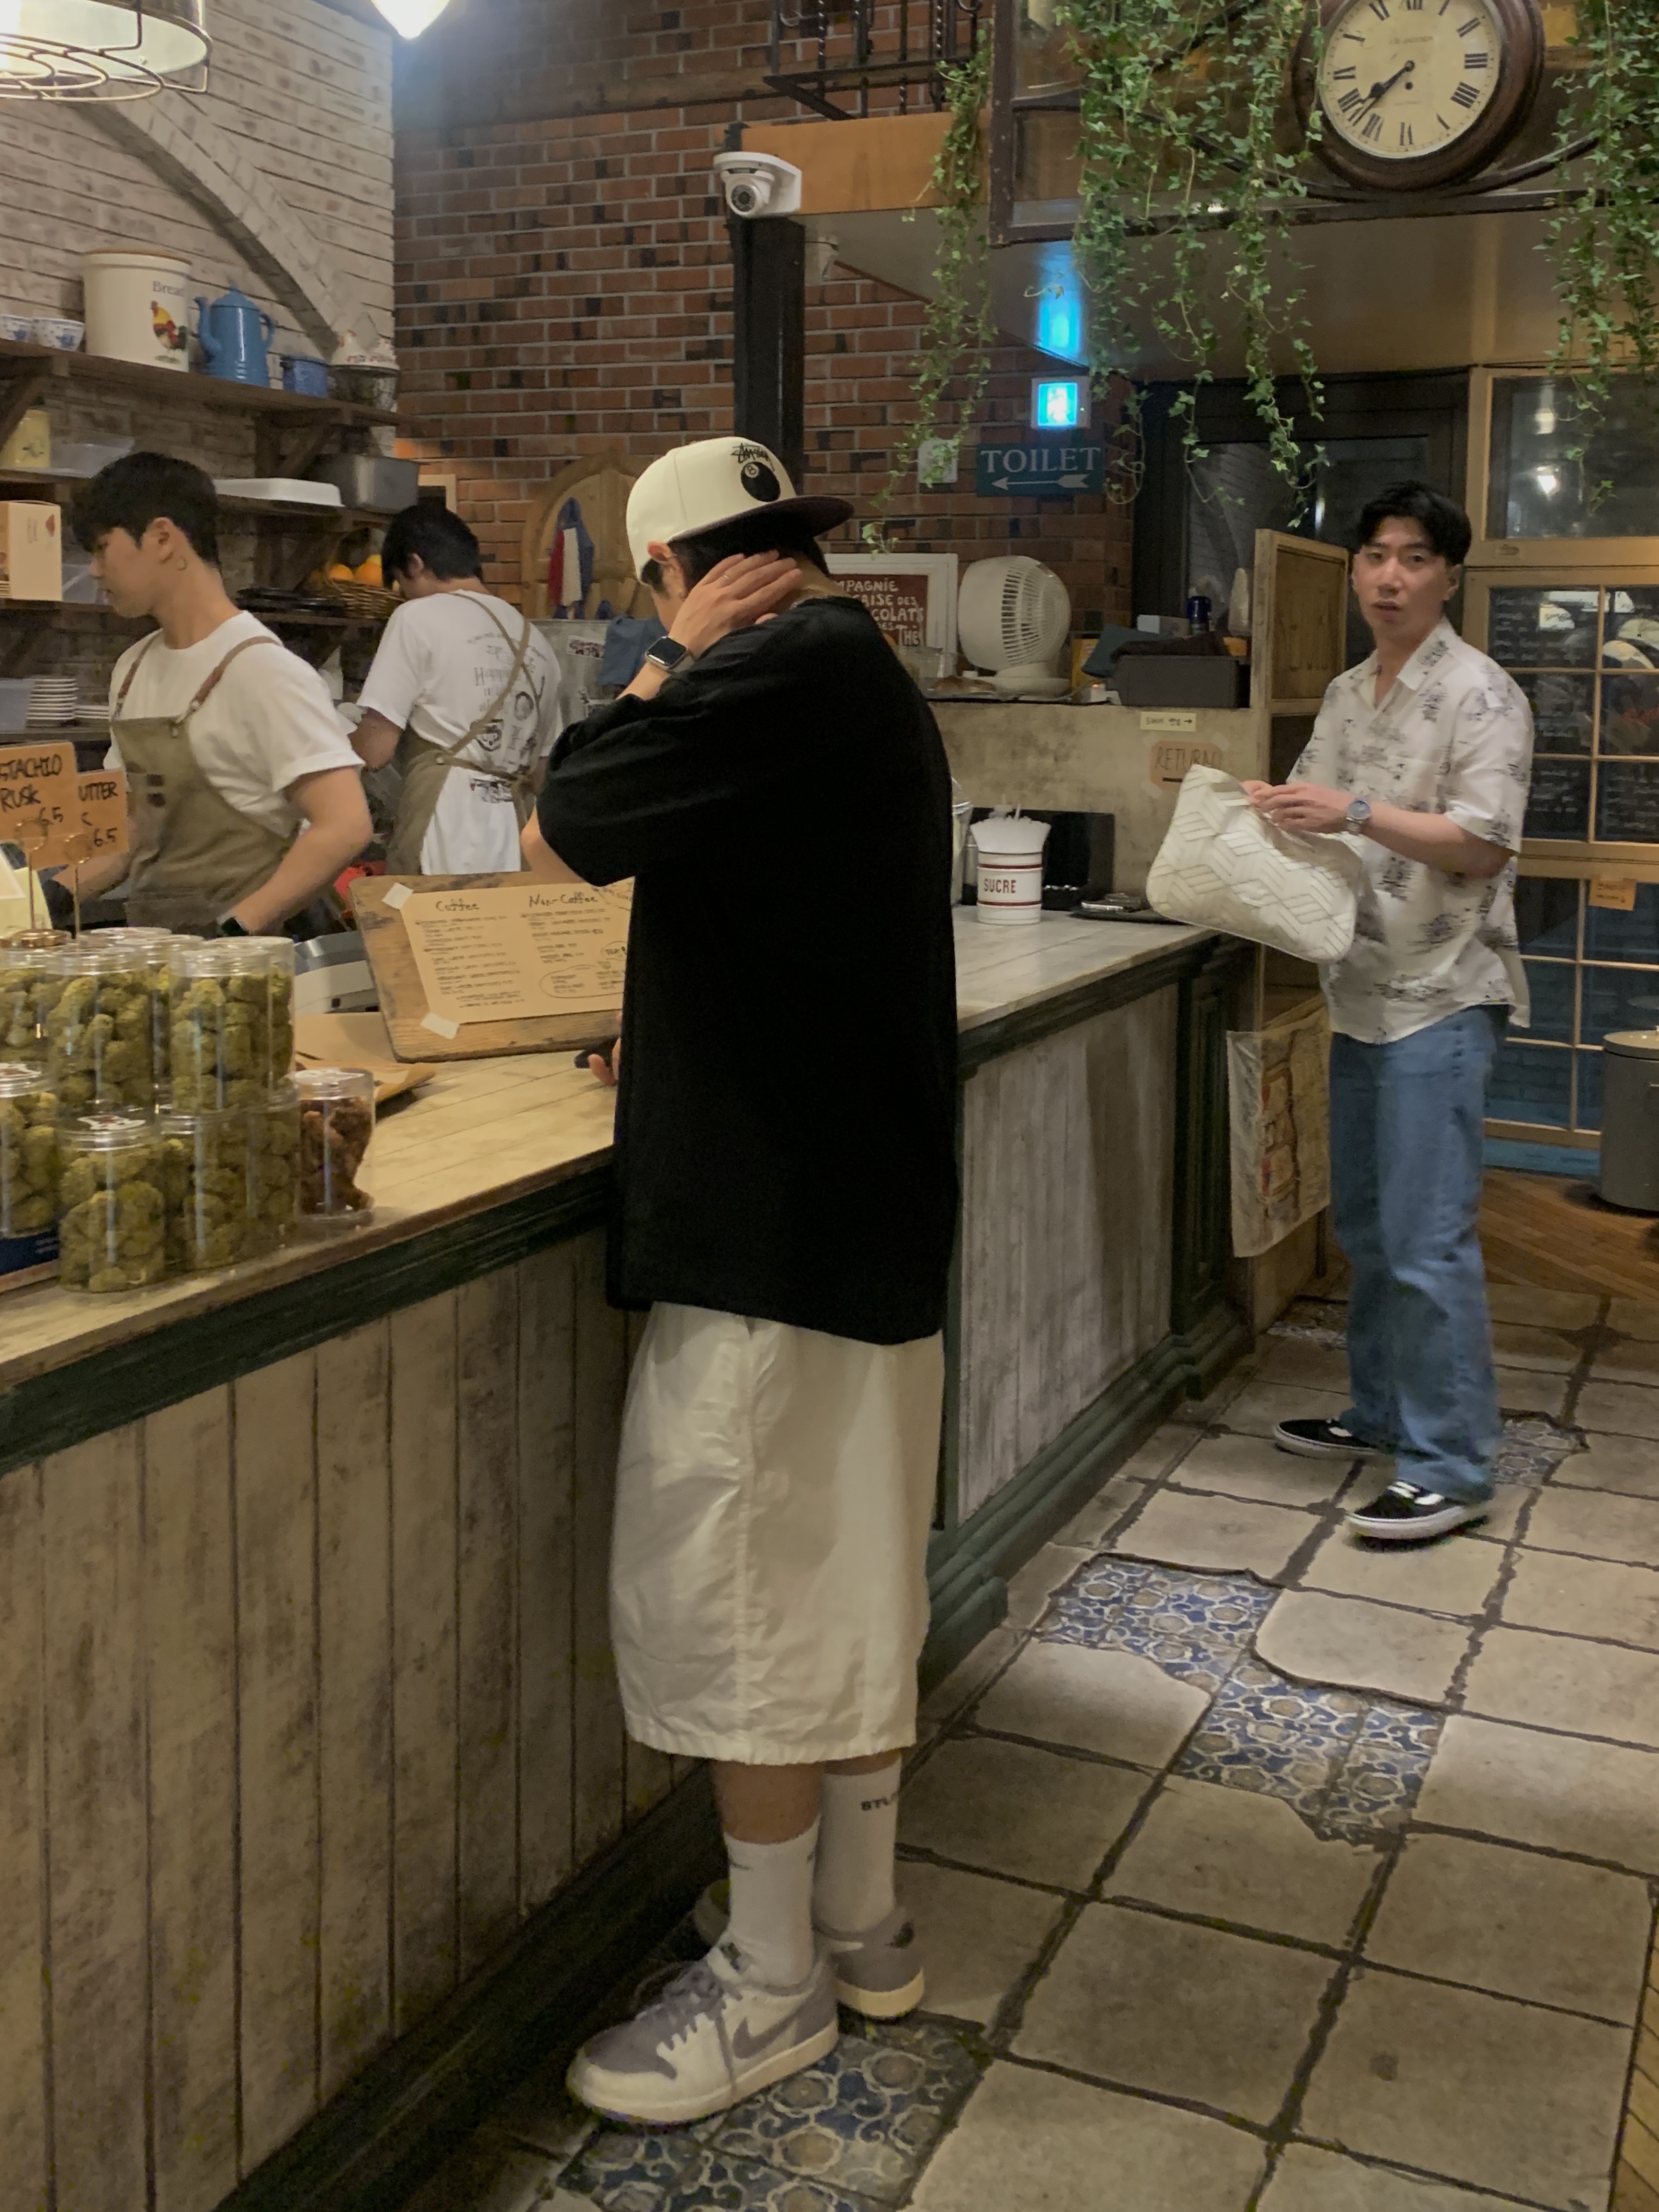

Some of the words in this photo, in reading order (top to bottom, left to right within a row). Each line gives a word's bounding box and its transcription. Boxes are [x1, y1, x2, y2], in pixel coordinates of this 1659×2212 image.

[980, 447, 1101, 473] TOILET
[897, 596, 916, 605] DES
[1155, 746, 1217, 771] RETURN
[1, 784, 41, 813] RUSK
[78, 781, 119, 802] UTTER
[984, 878, 1017, 894] SUCRE
[435, 898, 480, 912] Coffee
